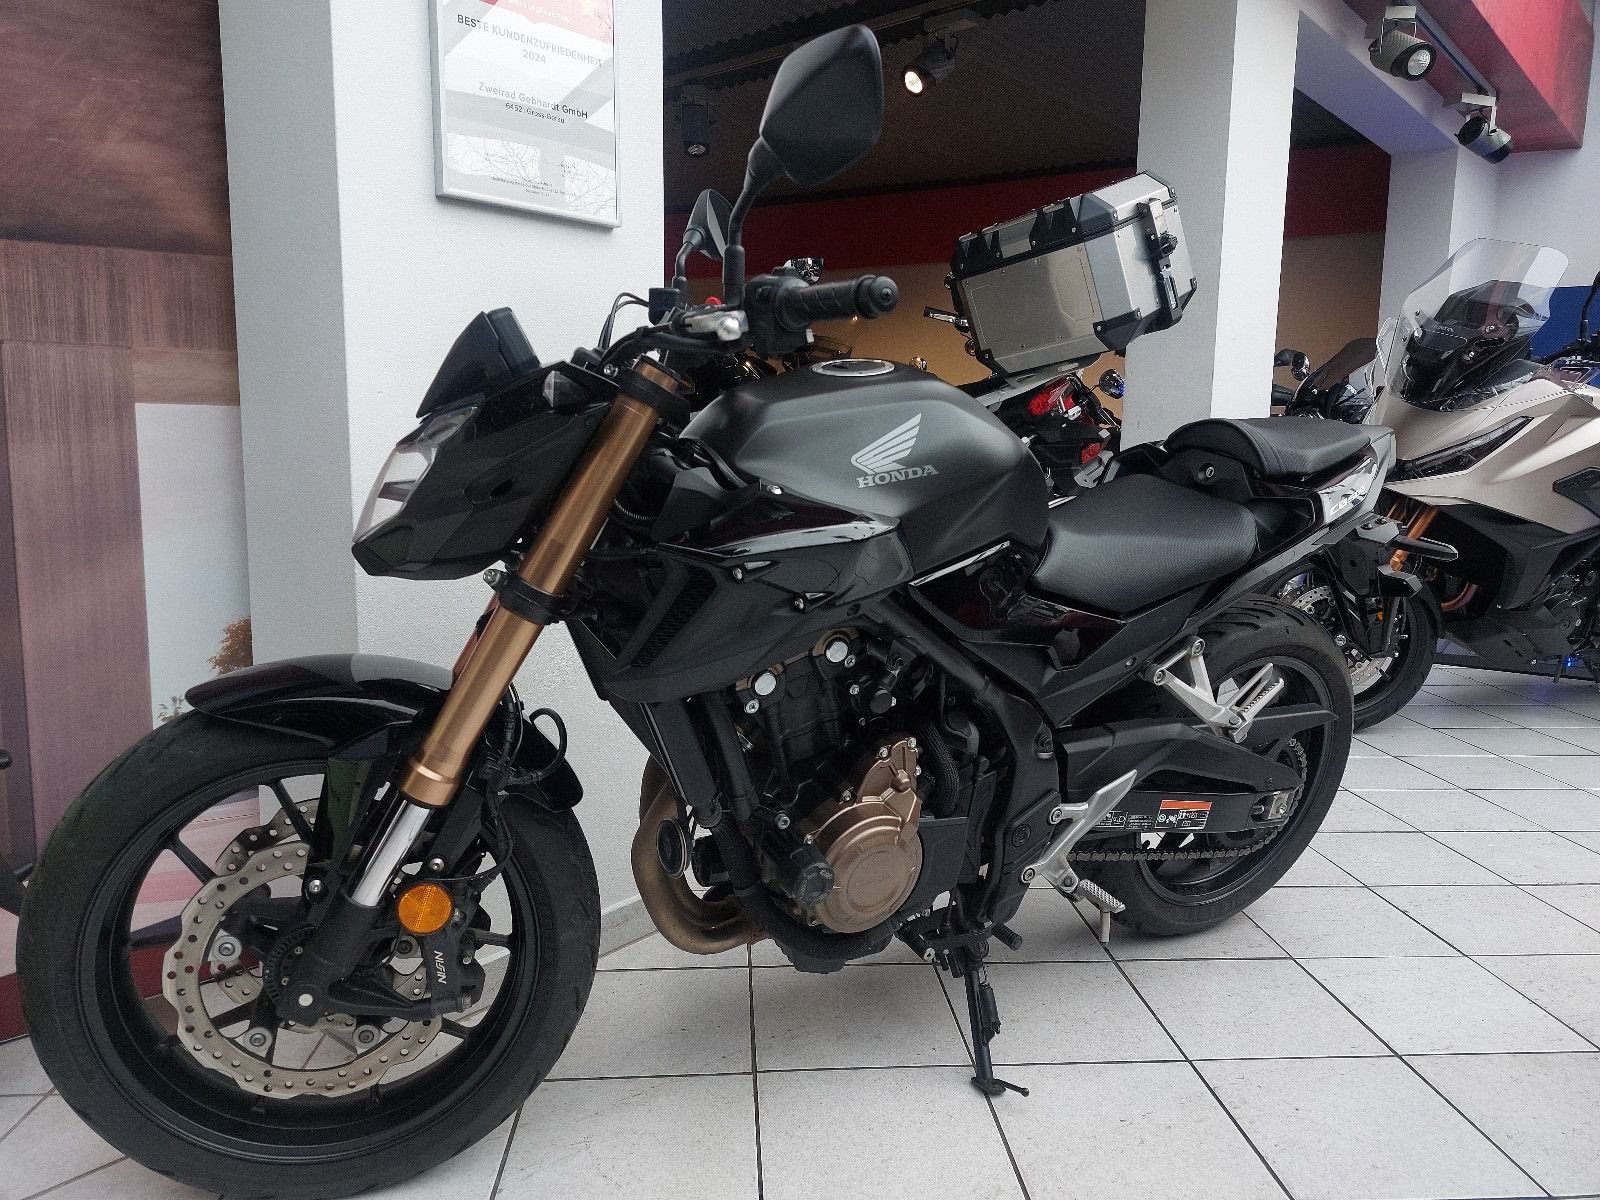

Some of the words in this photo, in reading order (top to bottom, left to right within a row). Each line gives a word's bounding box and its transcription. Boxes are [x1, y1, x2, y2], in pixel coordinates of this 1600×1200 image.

[457, 14, 489, 32] BESTE
[492, 25, 603, 67] KUNDENZUFRIEDENHEIT
[522, 50, 546, 64] 2024
[478, 82, 516, 100] Zweirad
[518, 93, 559, 111] Gebhardt
[562, 105, 588, 119] GmbH
[856, 464, 939, 488] HONDA
[433, 950, 447, 985] NISSIN
